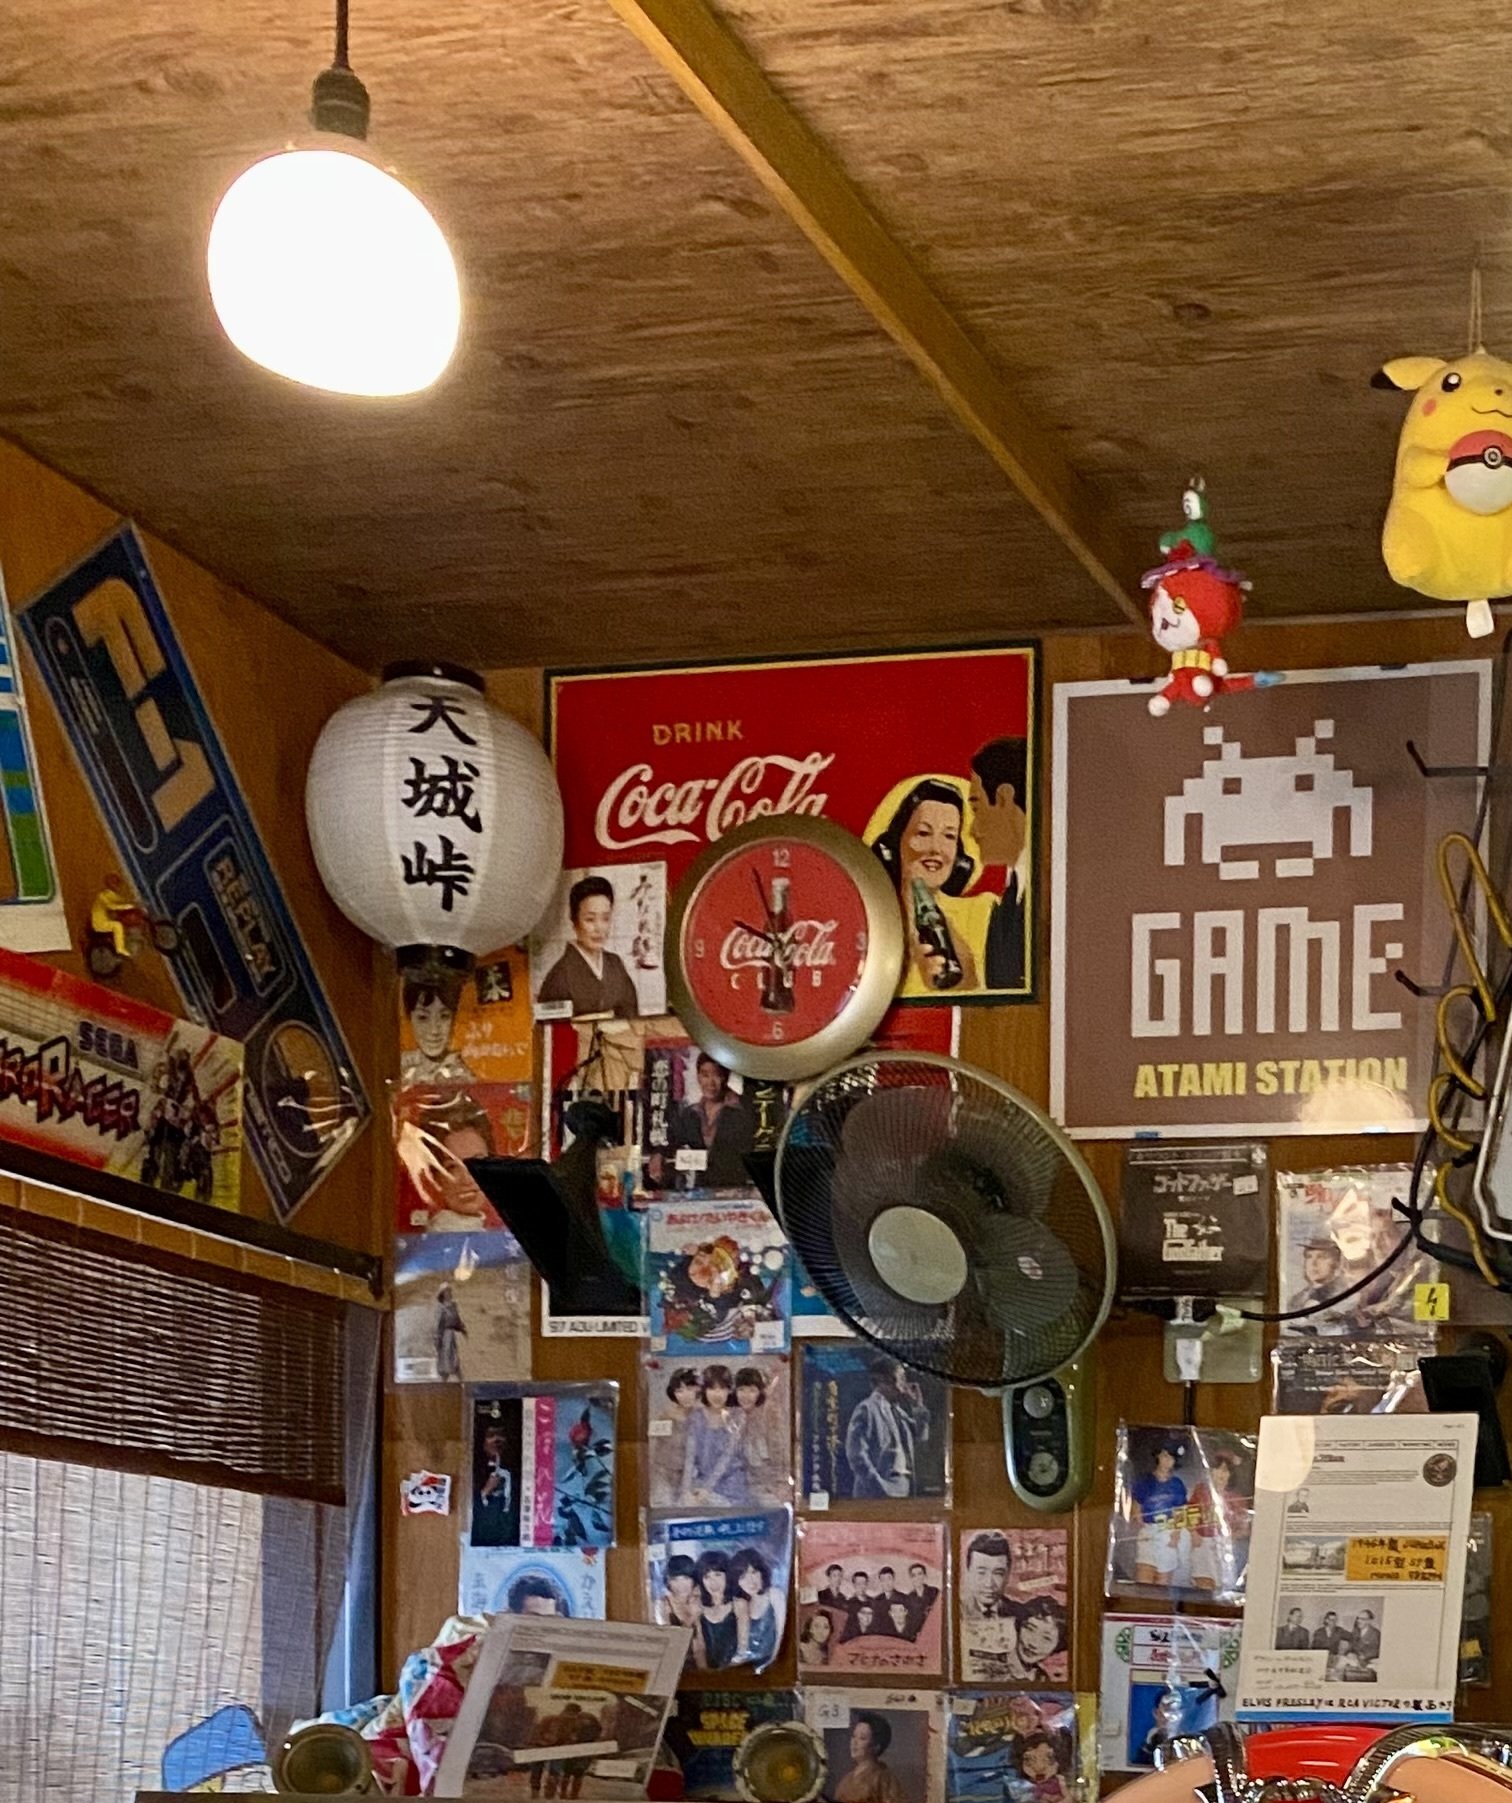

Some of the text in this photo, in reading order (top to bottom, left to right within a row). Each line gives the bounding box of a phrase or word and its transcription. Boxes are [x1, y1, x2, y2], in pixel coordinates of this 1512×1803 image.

[653, 720, 743, 746] DRINK
[401, 695, 483, 913] 天城峠
[1132, 903, 1404, 1038] GAME
[79, 1019, 139, 1070] SEGA
[772, 1023, 785, 1041] 6
[1134, 1057, 1408, 1099] ATAMI STATION
[1240, 1697, 1271, 1709] ELVIS
[1274, 1698, 1322, 1710] PRESLEY
